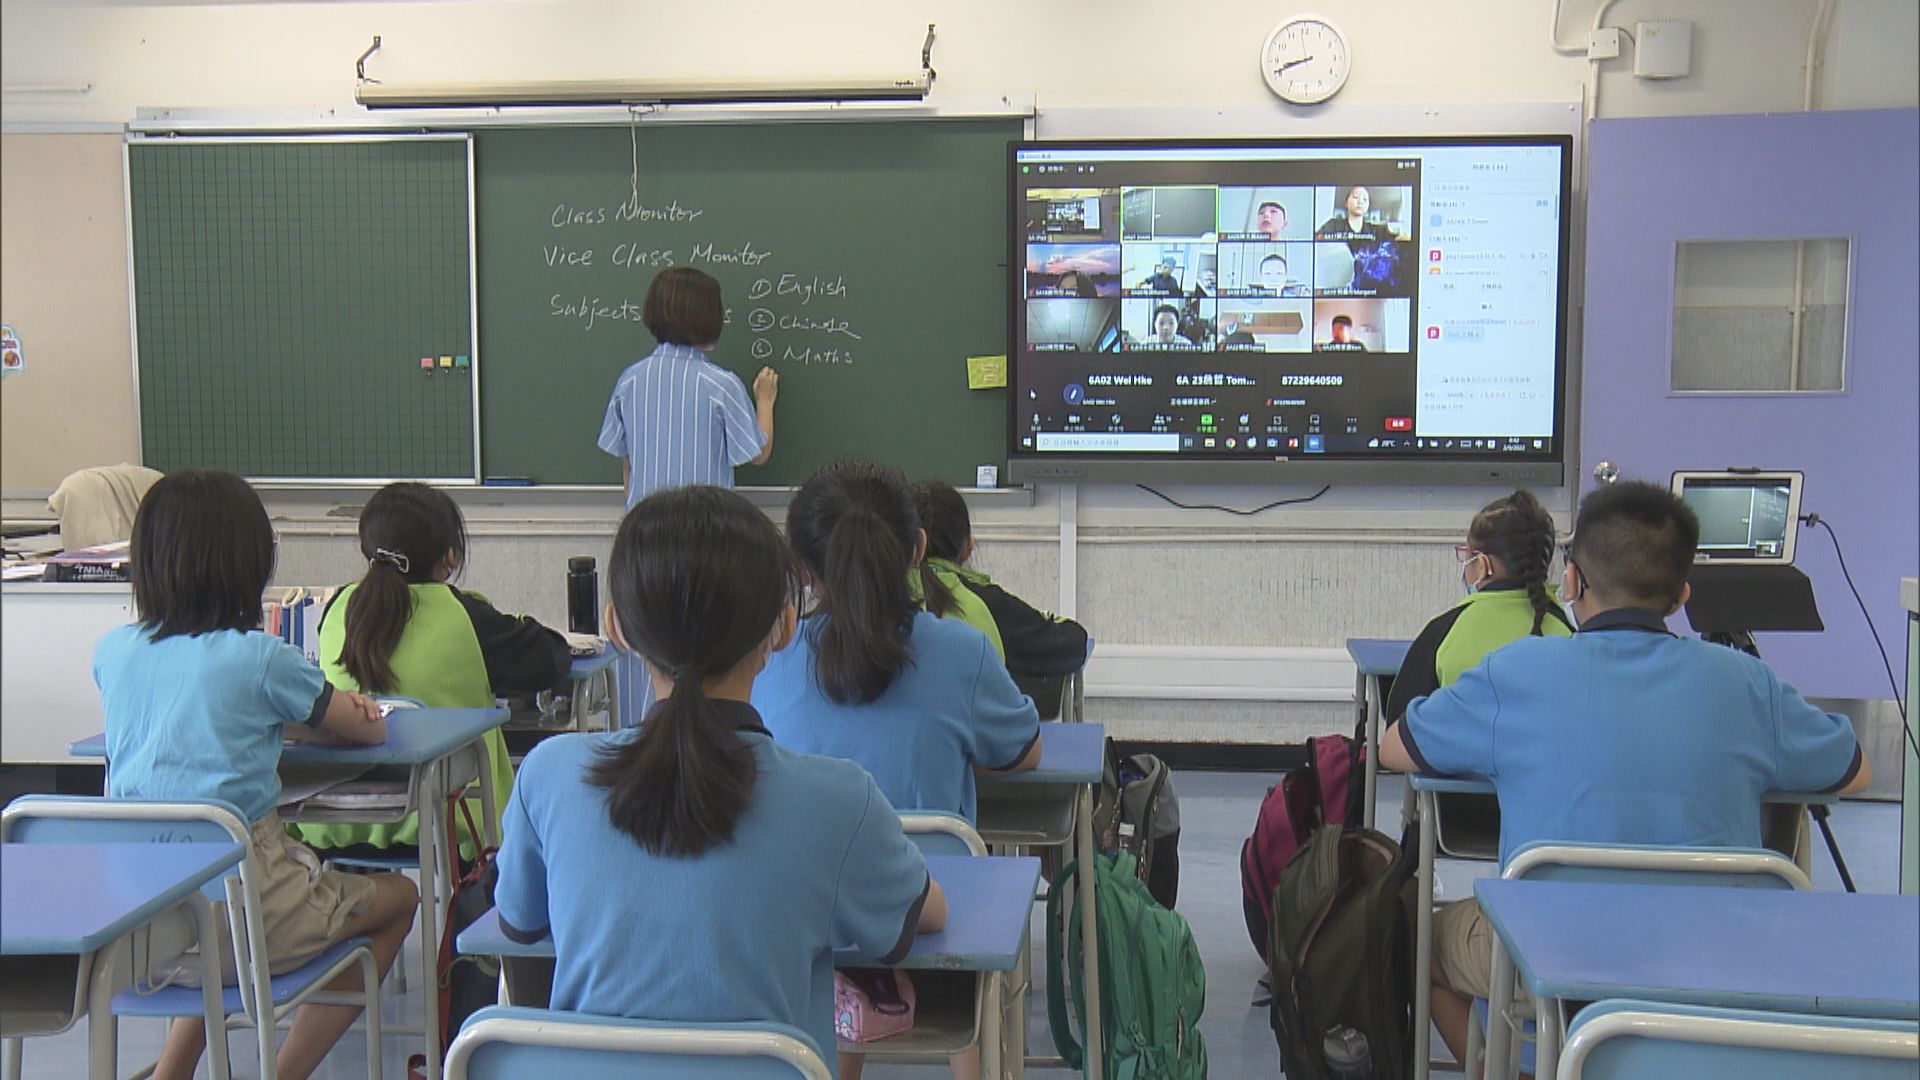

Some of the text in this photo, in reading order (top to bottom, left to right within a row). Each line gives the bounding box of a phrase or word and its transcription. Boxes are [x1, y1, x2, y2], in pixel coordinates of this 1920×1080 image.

[551, 200, 703, 227] Class Monitor
[543, 242, 771, 268] Vice Class Monitor
[777, 273, 847, 305] English
[550, 294, 641, 331] Subjects
[783, 345, 853, 365] Maths
[1088, 376, 1112, 385] 6A02
[1176, 376, 1189, 385] 6A
